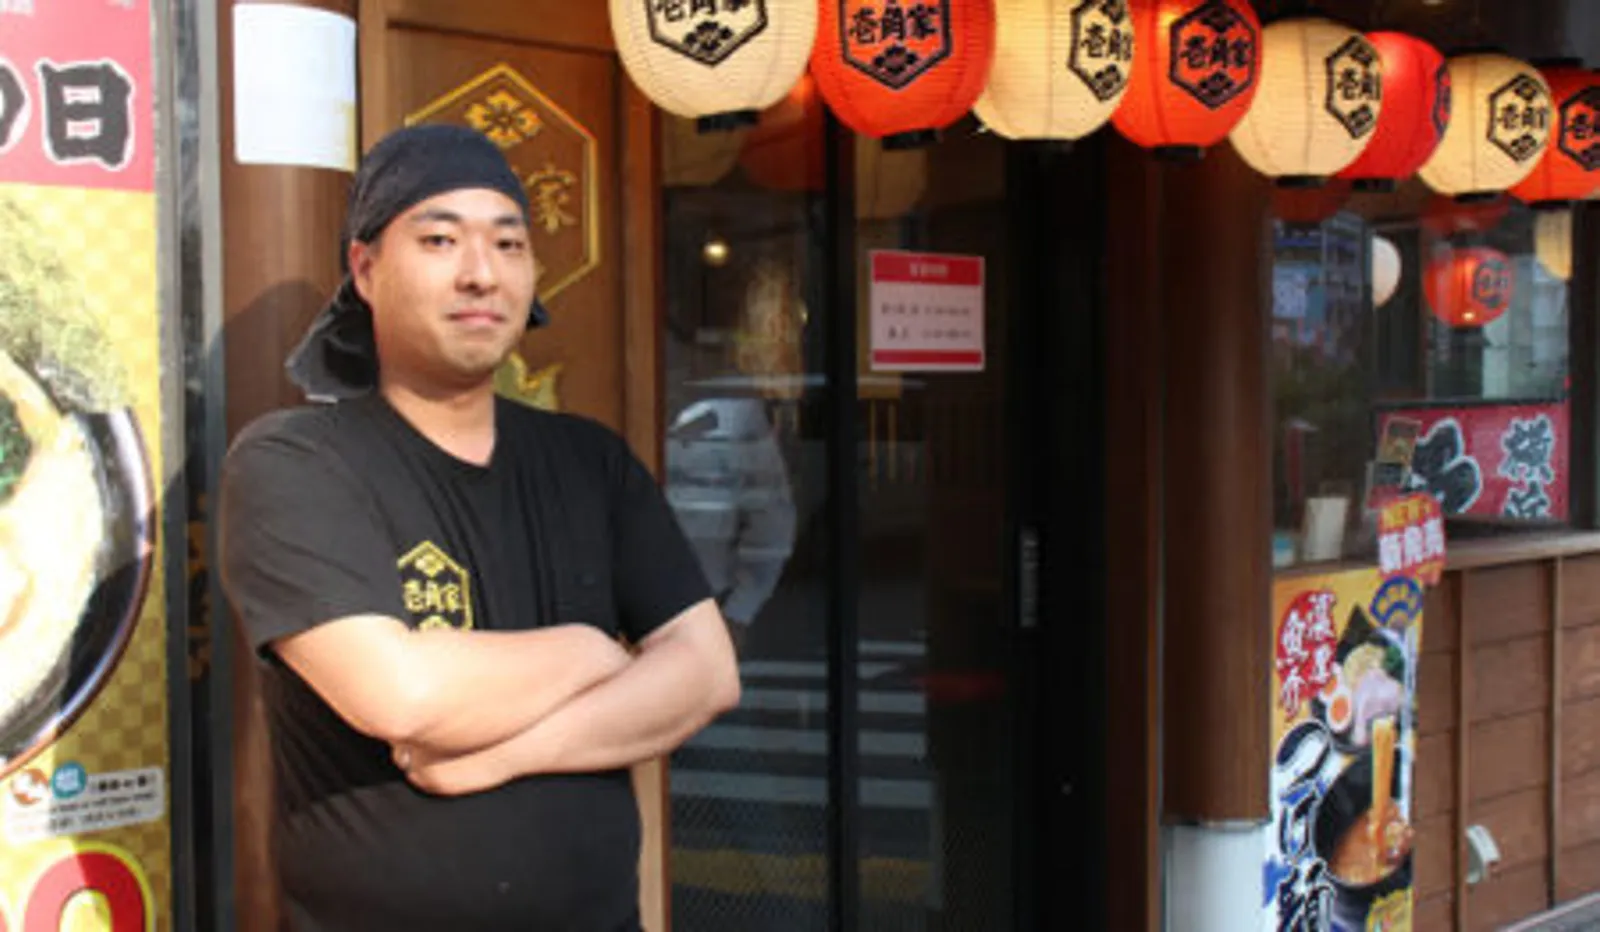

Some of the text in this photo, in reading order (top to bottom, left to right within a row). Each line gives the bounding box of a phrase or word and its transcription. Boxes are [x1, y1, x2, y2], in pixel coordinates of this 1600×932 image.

[848, 3, 940, 44] 壱角家
[1181, 36, 1249, 68] 壱角家
[403, 579, 462, 613] 壱角家
